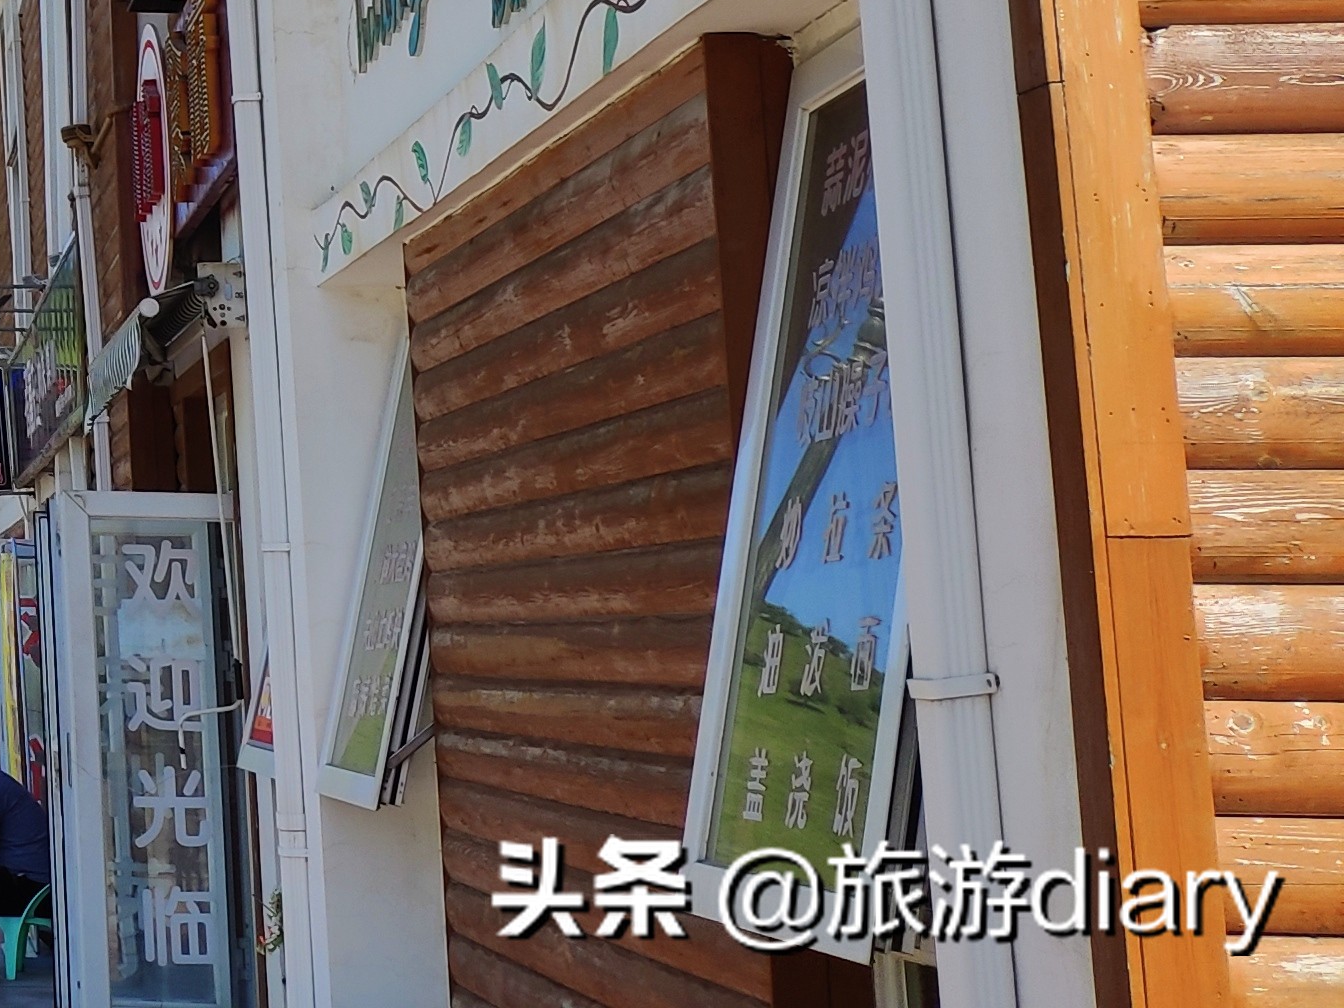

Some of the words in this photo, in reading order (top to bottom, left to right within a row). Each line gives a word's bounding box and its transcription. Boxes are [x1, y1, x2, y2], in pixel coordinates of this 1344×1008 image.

[821, 129, 872, 217] 蒜泥
[796, 350, 892, 448] 岐山臊子
[122, 540, 214, 967] 欢迎光临
[743, 747, 862, 838] 盖浇饭
